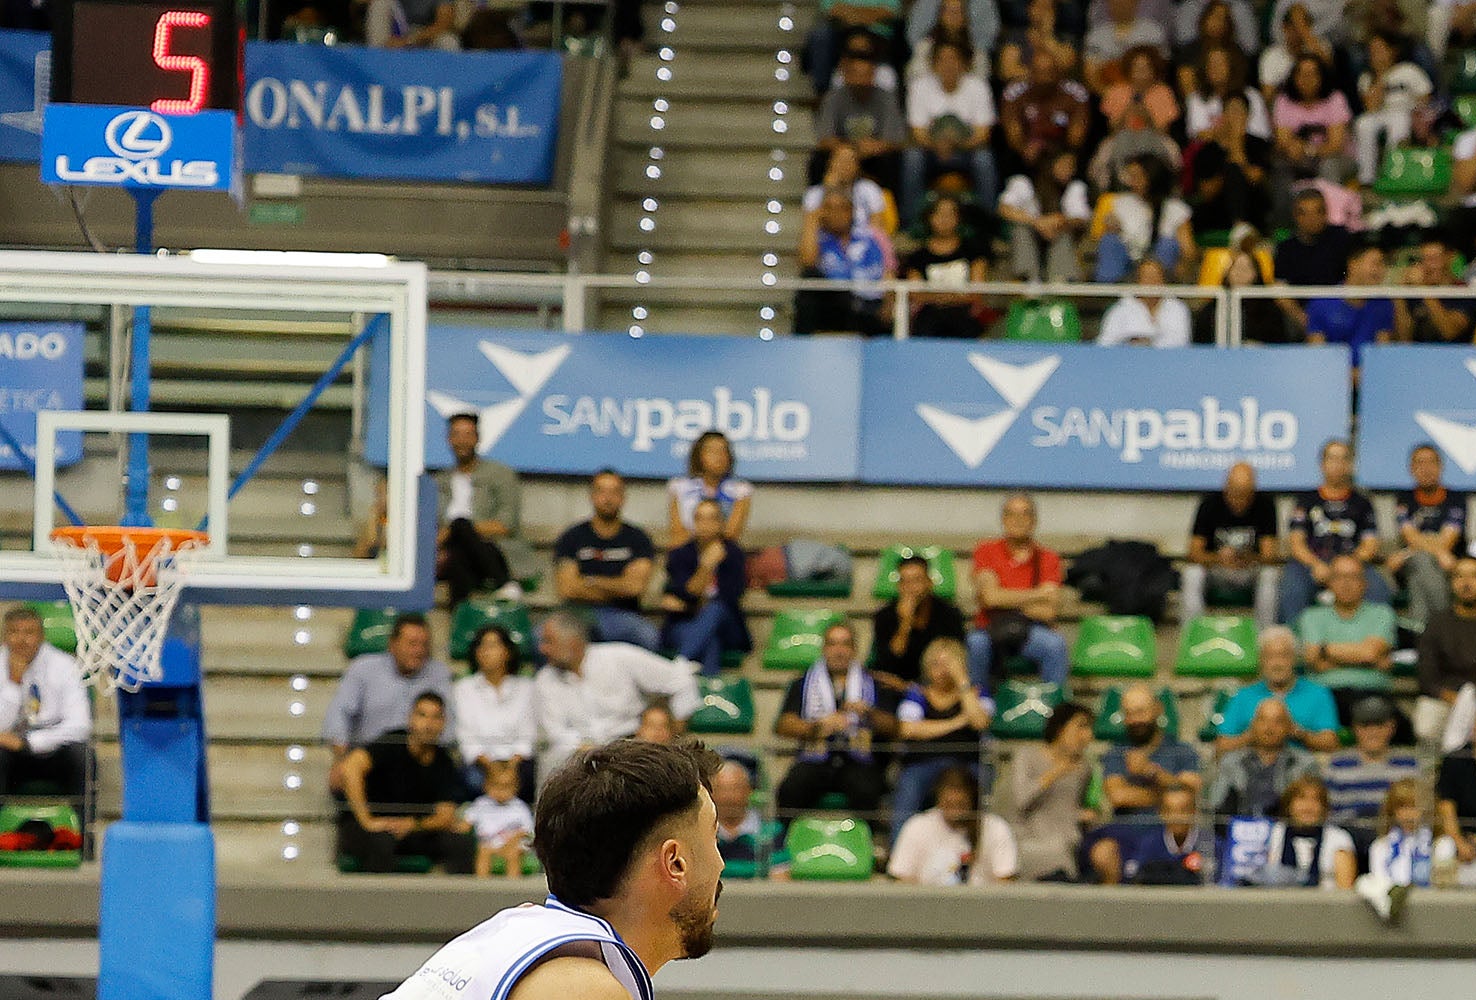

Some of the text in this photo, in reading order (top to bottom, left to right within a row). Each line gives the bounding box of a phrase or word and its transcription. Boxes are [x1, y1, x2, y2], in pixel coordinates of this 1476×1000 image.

[151, 11, 210, 116] 5
[55, 154, 219, 187] LEXUS
[1030, 395, 1300, 463] SANpablo
